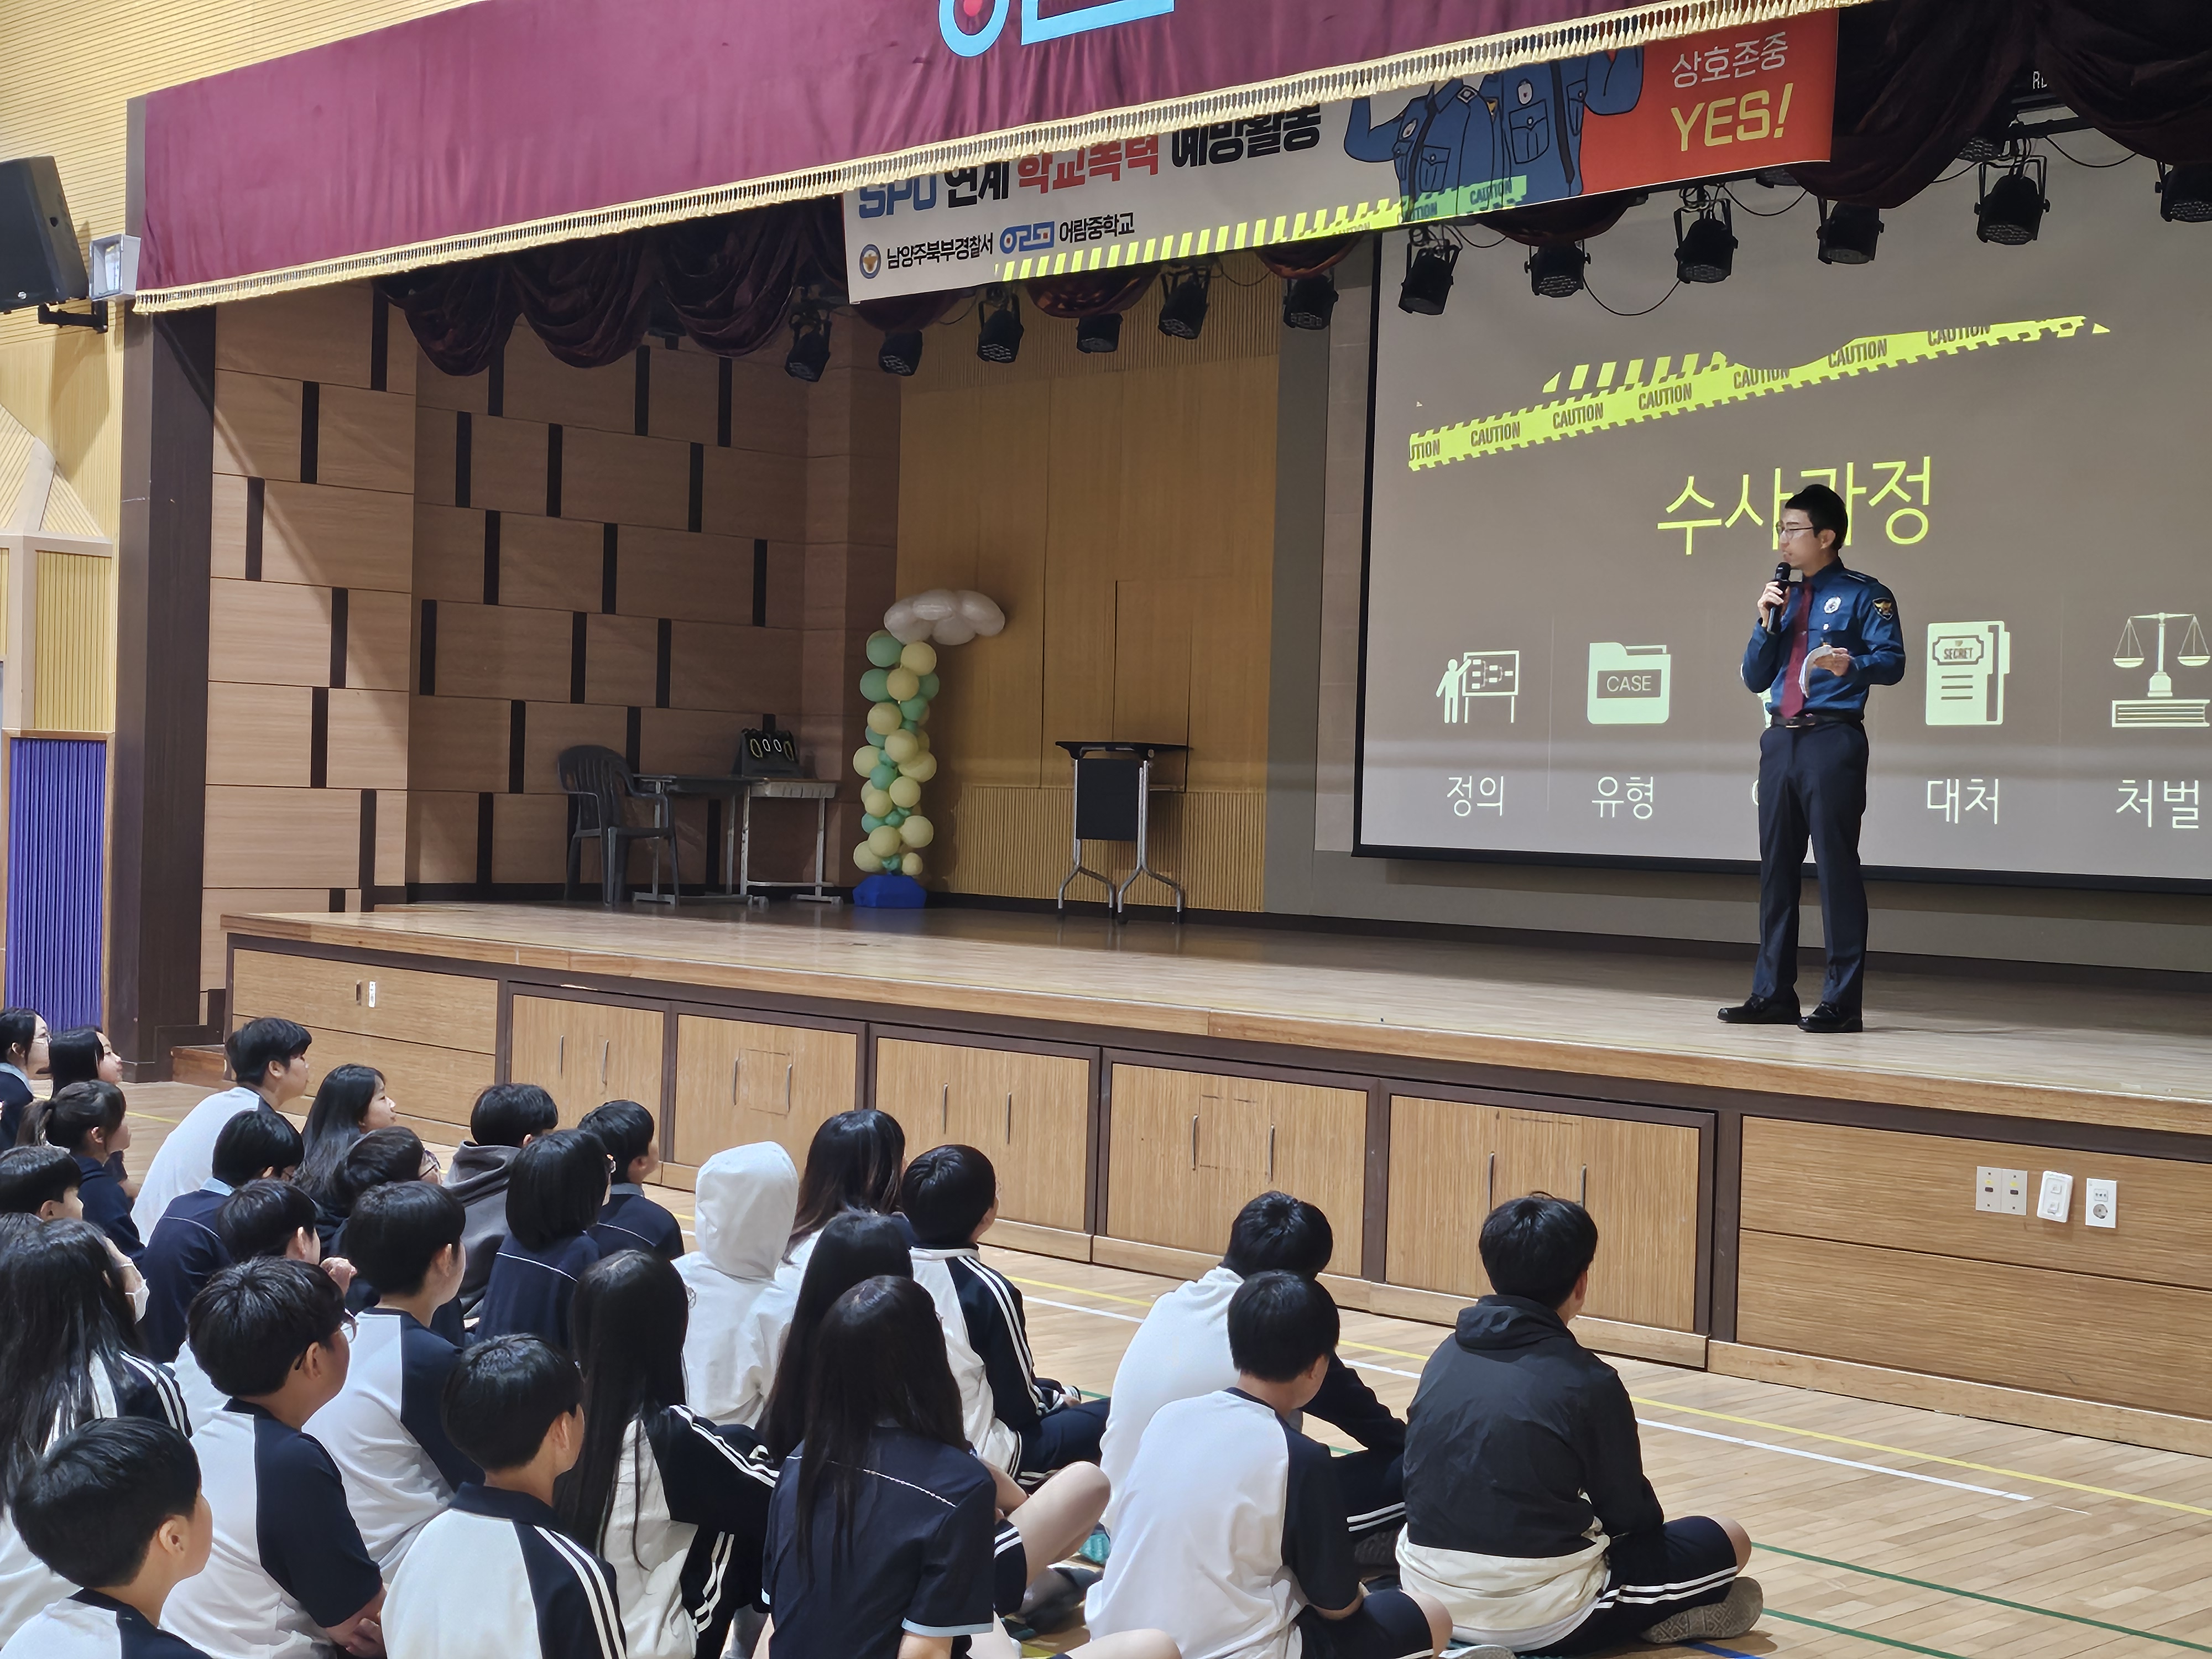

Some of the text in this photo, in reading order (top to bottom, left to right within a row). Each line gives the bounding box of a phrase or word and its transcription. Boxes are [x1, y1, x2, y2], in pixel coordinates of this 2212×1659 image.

[1671, 31, 1788, 88] 상호존중
[1670, 82, 1794, 152] YES!
[887, 232, 993, 270] 남양주북부경찰서
[1059, 212, 1135, 244] 어람중학교
[1470, 421, 1521, 447] CAUTION
[1552, 402, 1604, 429] CAUTION
[1638, 383, 1693, 410] CAUTION
[1827, 338, 1887, 368] CAUTION
[1606, 675, 1652, 692] CASE
[1447, 775, 2200, 830] 정의 유형 대처 처벌
